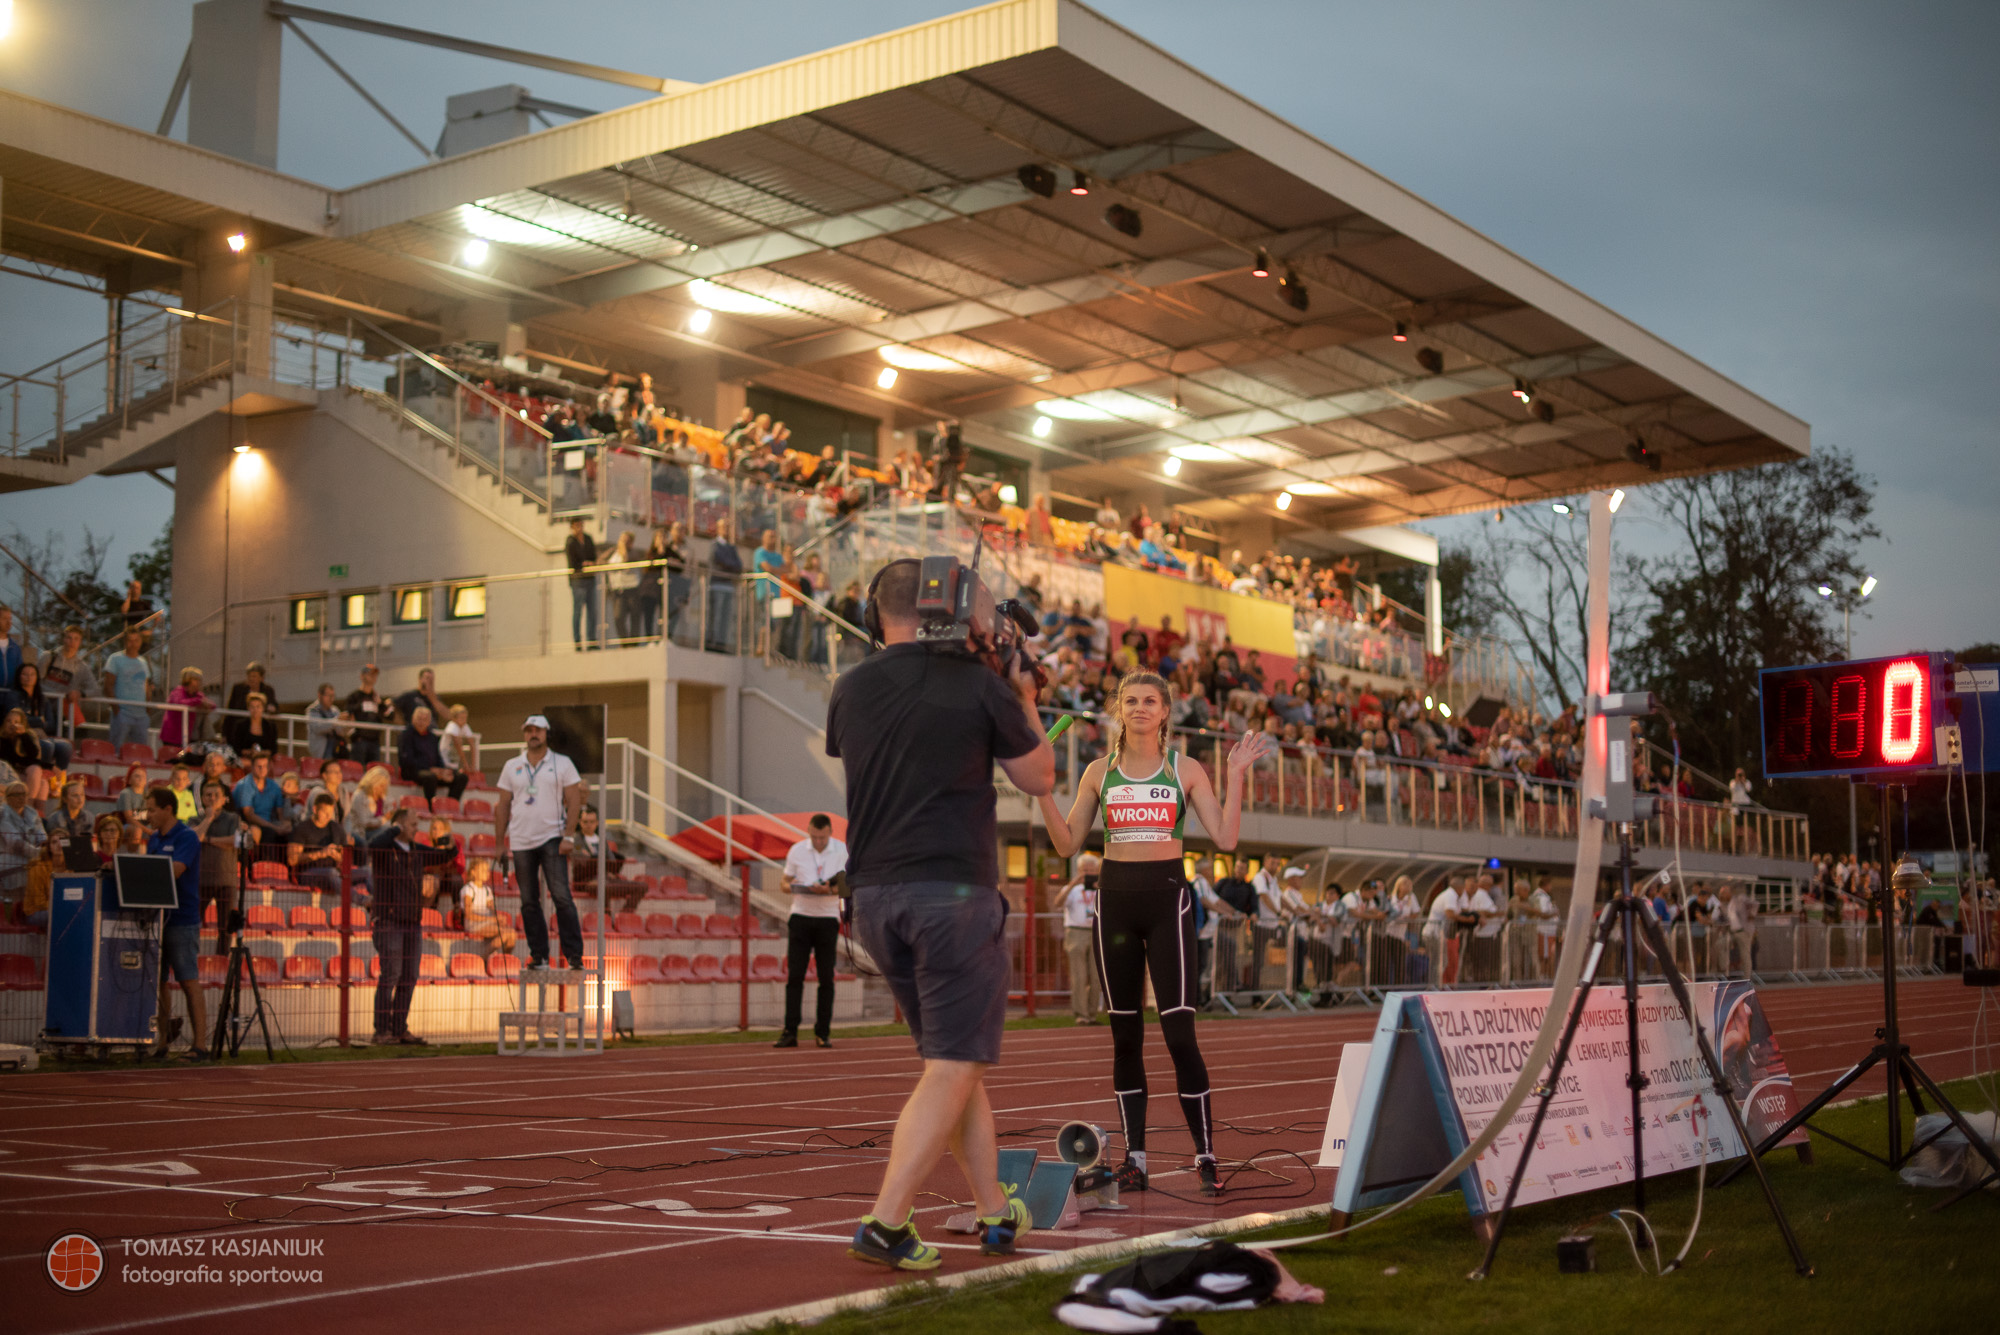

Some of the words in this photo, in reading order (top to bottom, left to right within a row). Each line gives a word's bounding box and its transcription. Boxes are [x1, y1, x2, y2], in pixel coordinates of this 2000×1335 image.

[1150, 788, 1170, 799] 60
[1111, 808, 1169, 822] WRONA
[1434, 1010, 1473, 1037] PZLA
[1473, 1003, 1558, 1034] DRUŻYNO
[1569, 1008, 1624, 1032] AJWIĘKSZE
[1625, 1006, 1662, 1024] GIAZDY
[1575, 1041, 1612, 1062] LEKKIEJ
[1650, 1069, 1672, 1085] 17:00
[1670, 1056, 1713, 1083] 01.0.18
[1456, 1083, 1490, 1105] POLSKI
[1491, 1083, 1504, 1102] W
[1756, 1094, 1786, 1116] WSTĘP
[1544, 1106, 1577, 1120] NOWROCŁAW
